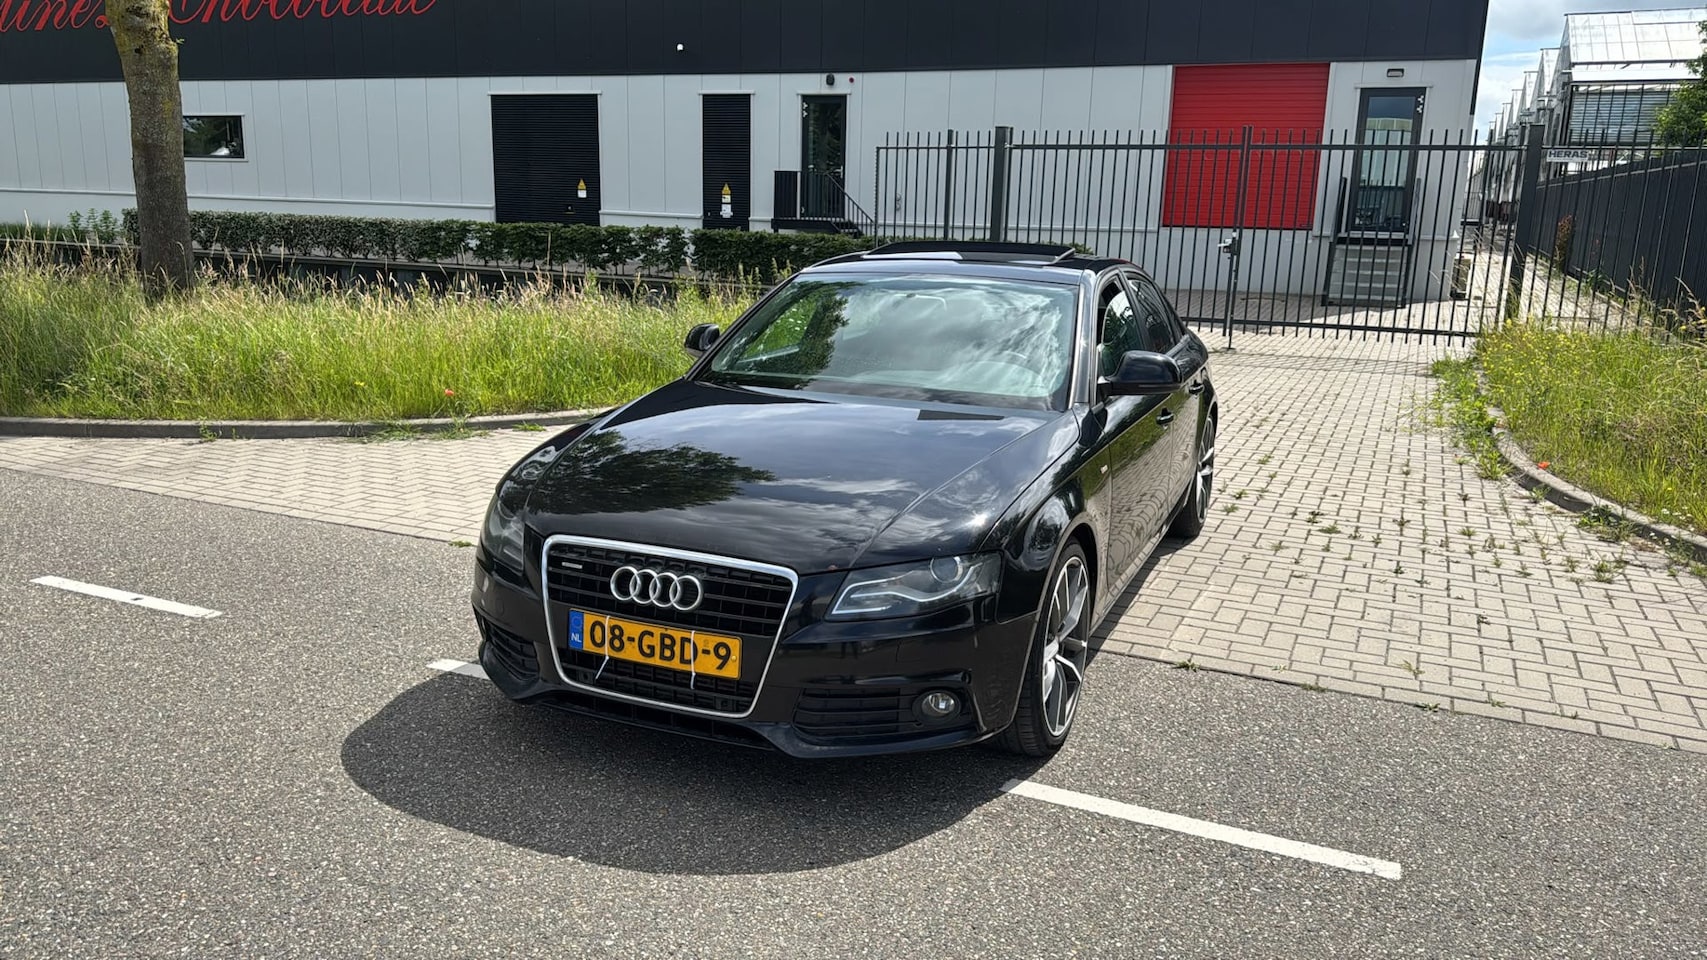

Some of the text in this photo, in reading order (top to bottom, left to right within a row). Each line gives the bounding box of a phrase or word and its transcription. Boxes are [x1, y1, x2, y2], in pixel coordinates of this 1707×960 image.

[1548, 150, 1588, 158] HERAS
[571, 633, 582, 643] NL
[590, 620, 731, 670] 08-GBD-9
